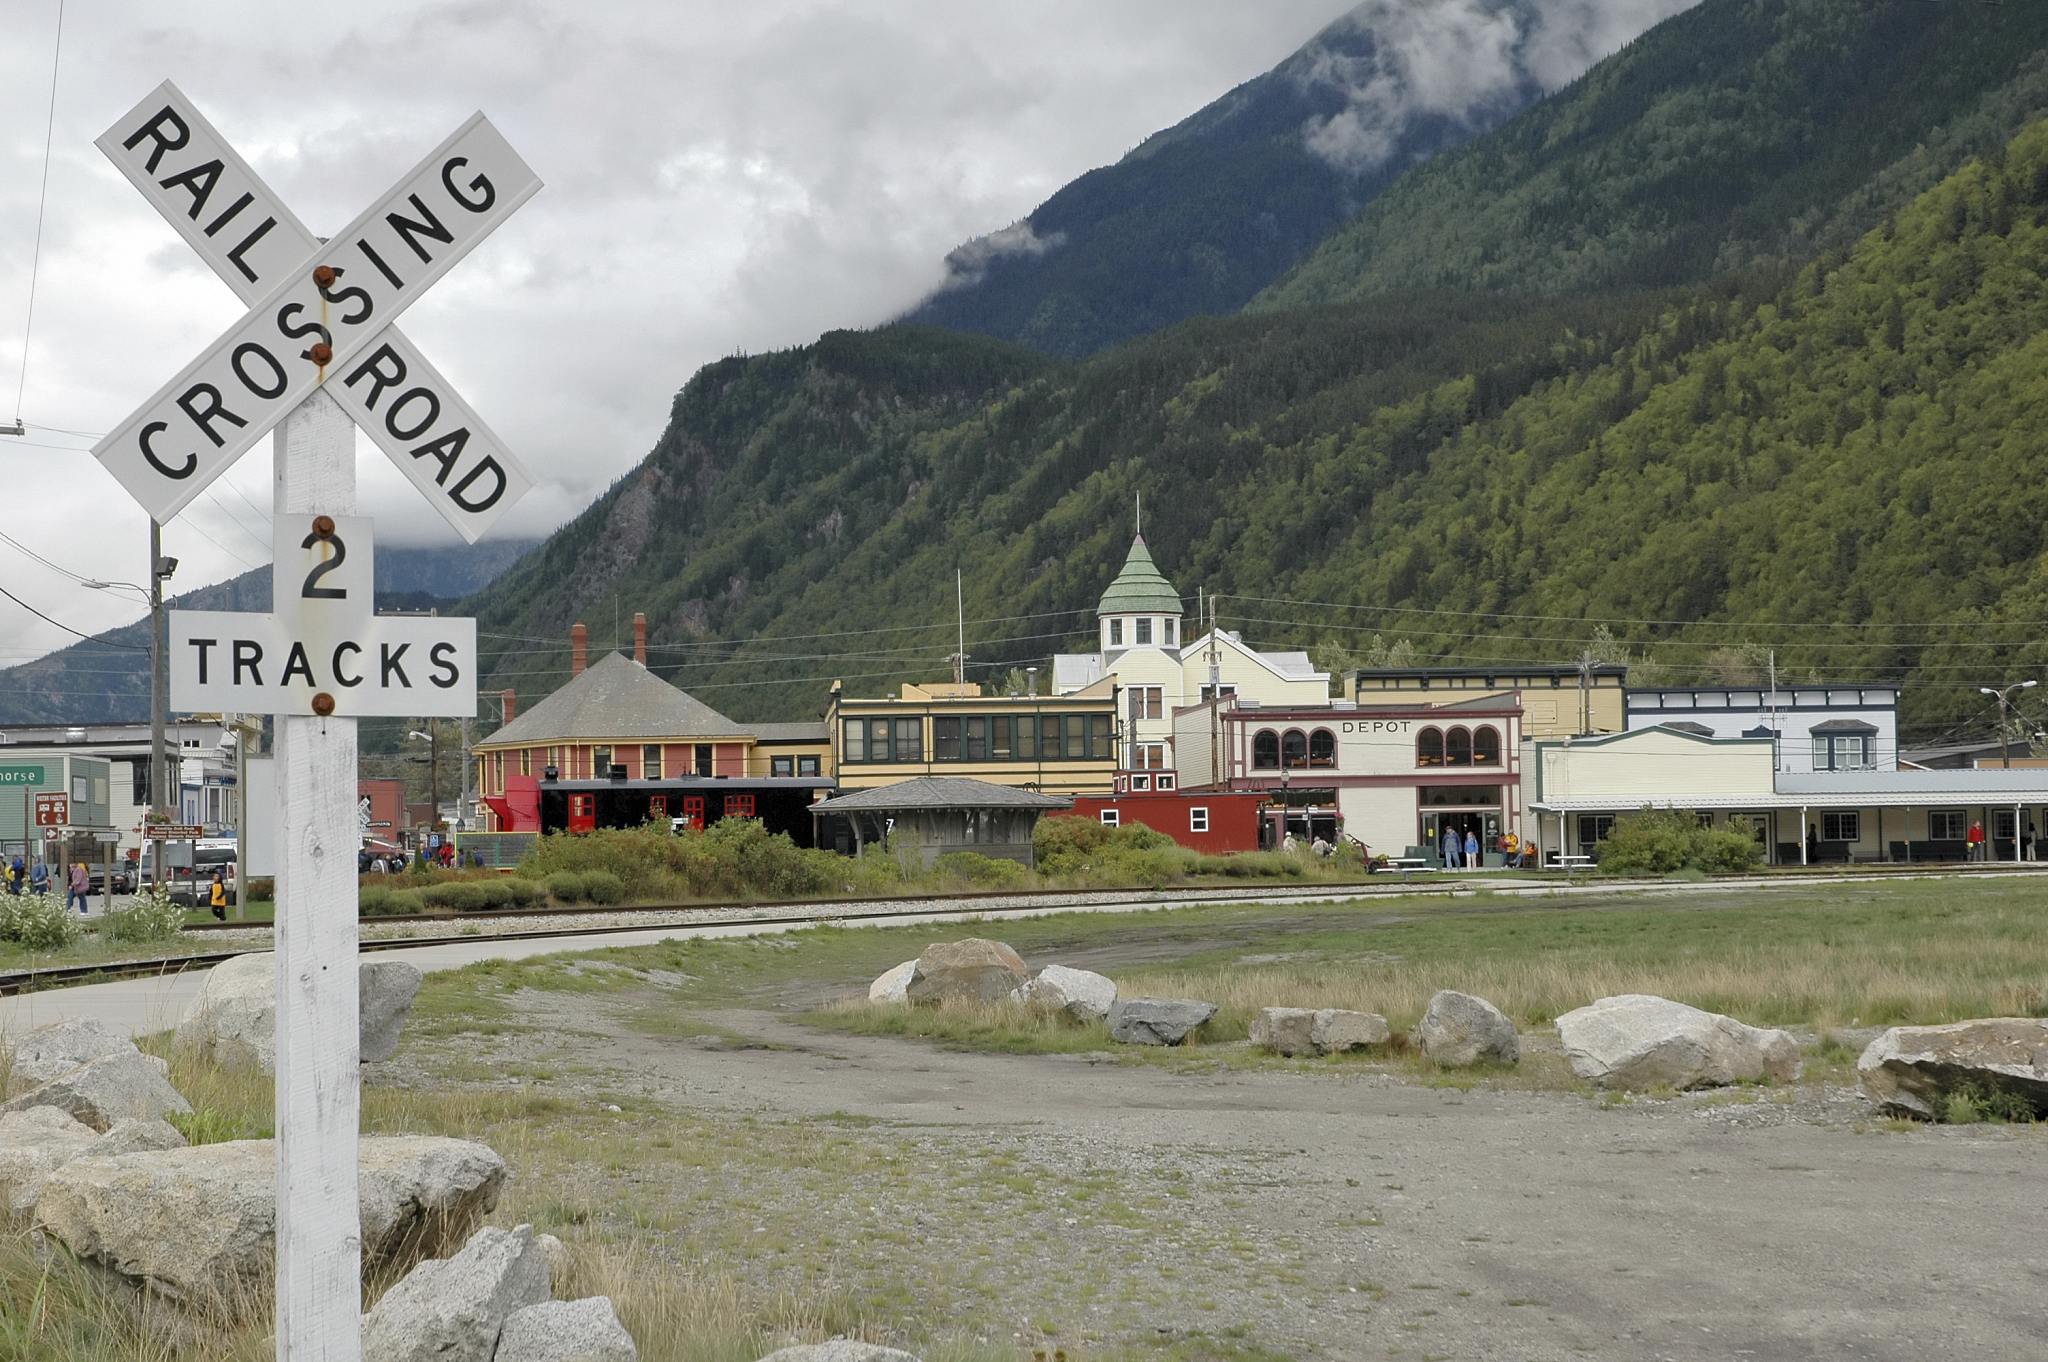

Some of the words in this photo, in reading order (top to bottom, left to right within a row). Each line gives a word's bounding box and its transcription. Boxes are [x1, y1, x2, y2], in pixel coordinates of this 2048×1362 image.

[122, 104, 278, 284] RAIL
[343, 342, 507, 514] ROAD
[138, 156, 497, 481] CROSSING
[301, 531, 347, 599] 2
[188, 638, 460, 688] TRACKS
[1342, 721, 1411, 733] DEPOT
